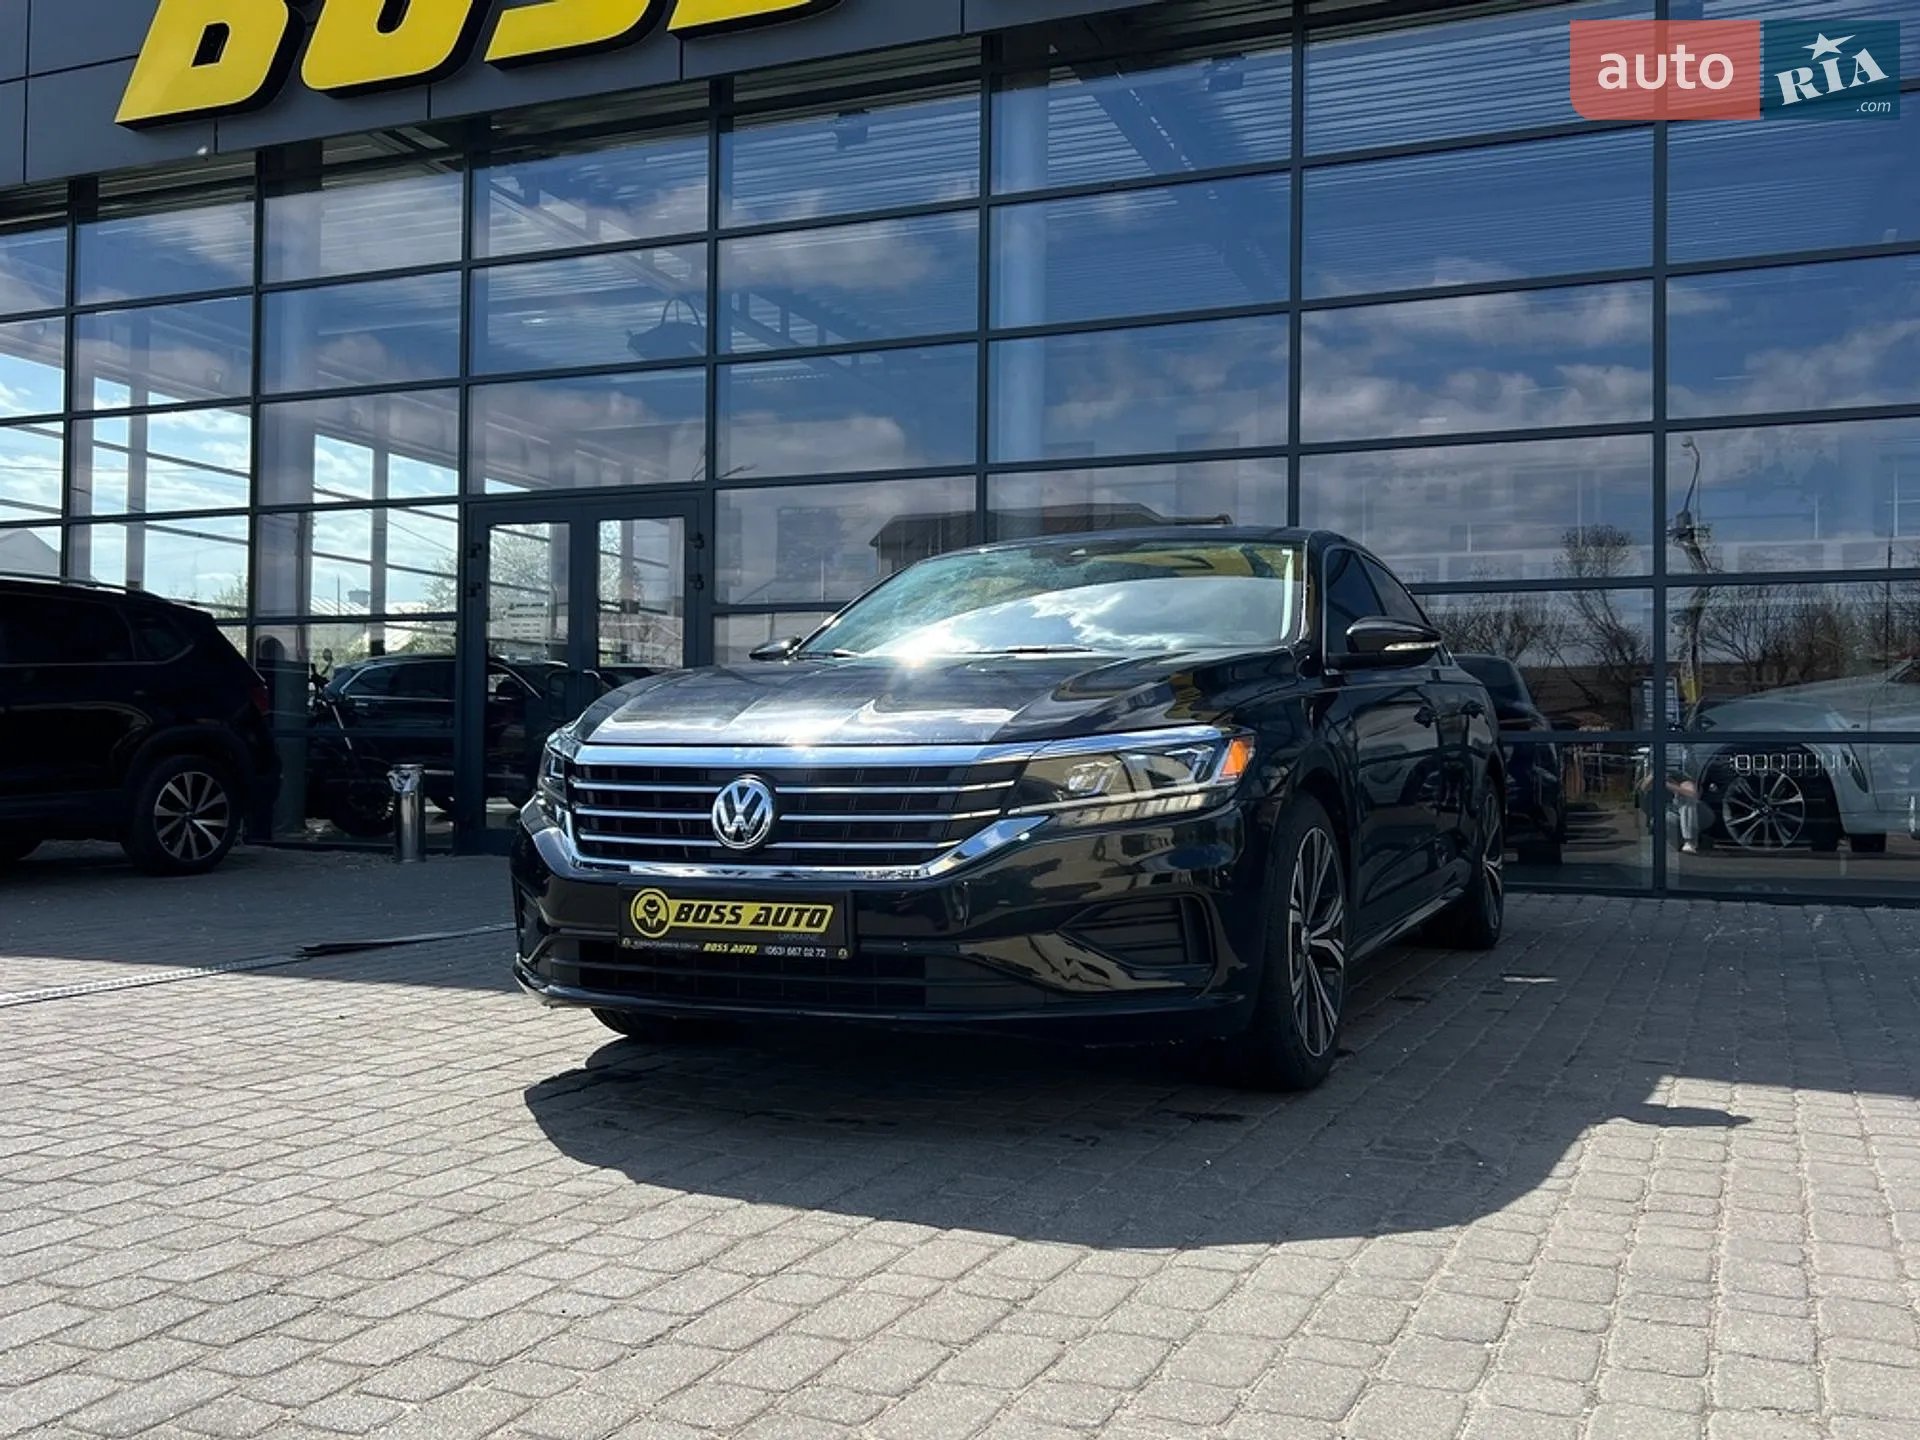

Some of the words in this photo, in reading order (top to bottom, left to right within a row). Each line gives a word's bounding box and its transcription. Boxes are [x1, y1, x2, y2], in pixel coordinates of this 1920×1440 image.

[674, 903, 744, 925] BOSS
[749, 906, 829, 928] AUTO
[703, 942, 728, 952] BOSS
[729, 944, 758, 954] AUTO
[764, 945, 786, 956] (063)
[816, 948, 827, 958] 72
